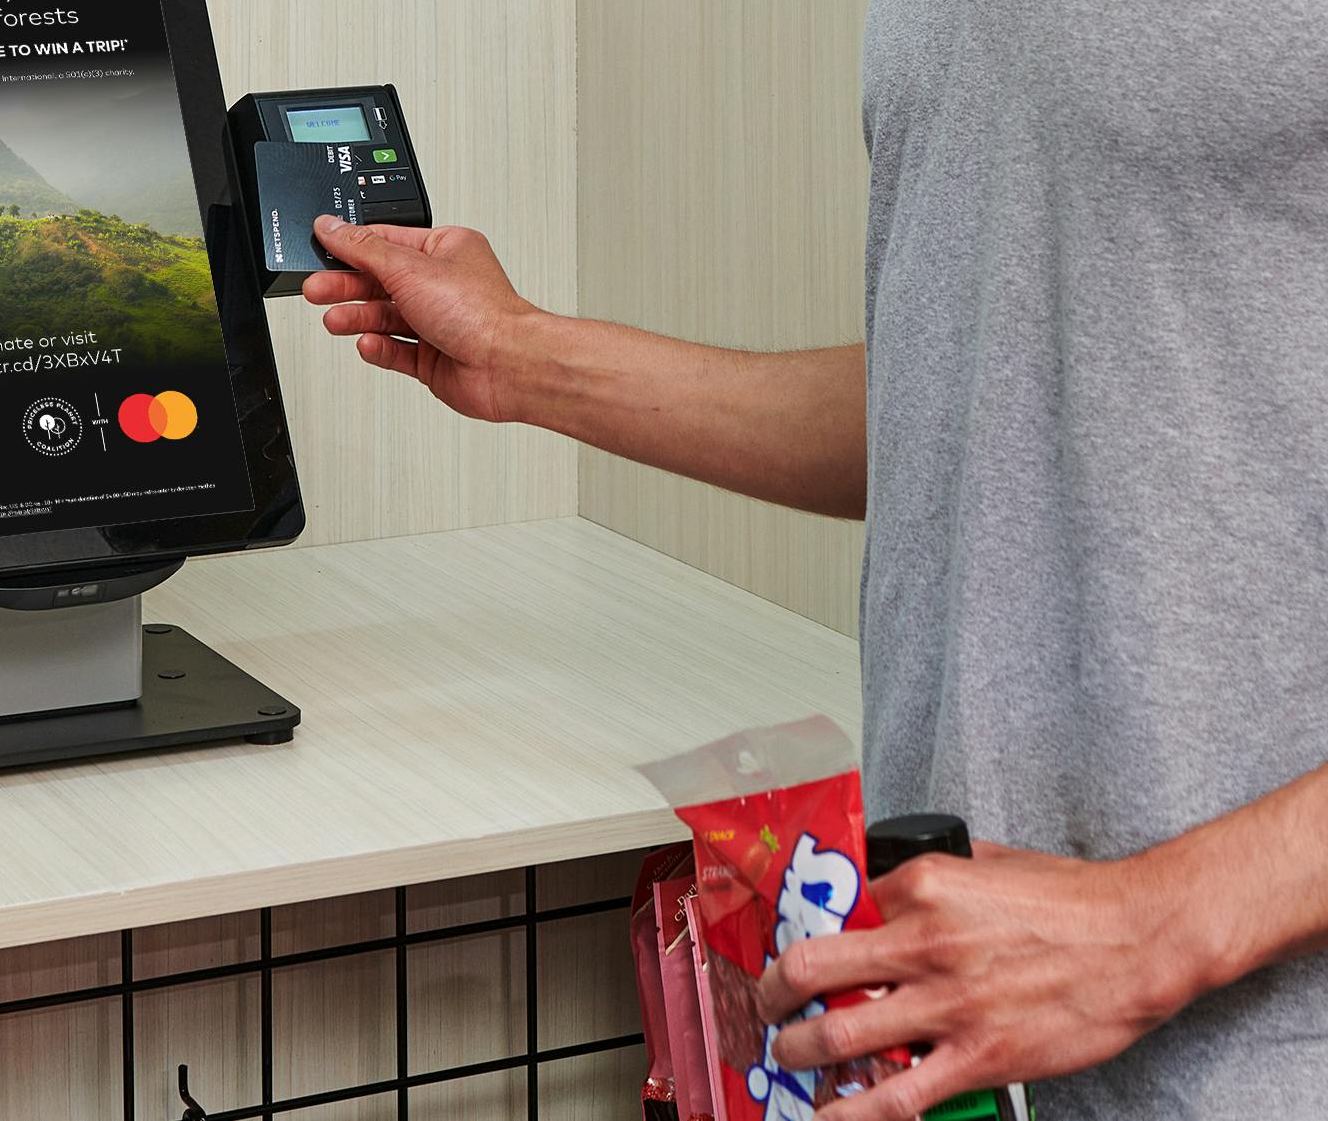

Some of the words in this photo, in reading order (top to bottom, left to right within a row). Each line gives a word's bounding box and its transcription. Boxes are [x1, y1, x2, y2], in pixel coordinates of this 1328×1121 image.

[8, 43, 32, 57] TO
[34, 41, 69, 56] WIN
[71, 41, 84, 54] A
[327, 145, 335, 163] DEBIT
[337, 145, 353, 174] VISA
[347, 198, 358, 226] USTOMER
[38, 335, 57, 348] or
[61, 330, 98, 347] visit
[27, 401, 54, 430] PRICELESS
[56, 401, 79, 426] PLANET
[91, 418, 109, 426] WITH
[36, 437, 75, 453] COALITION
